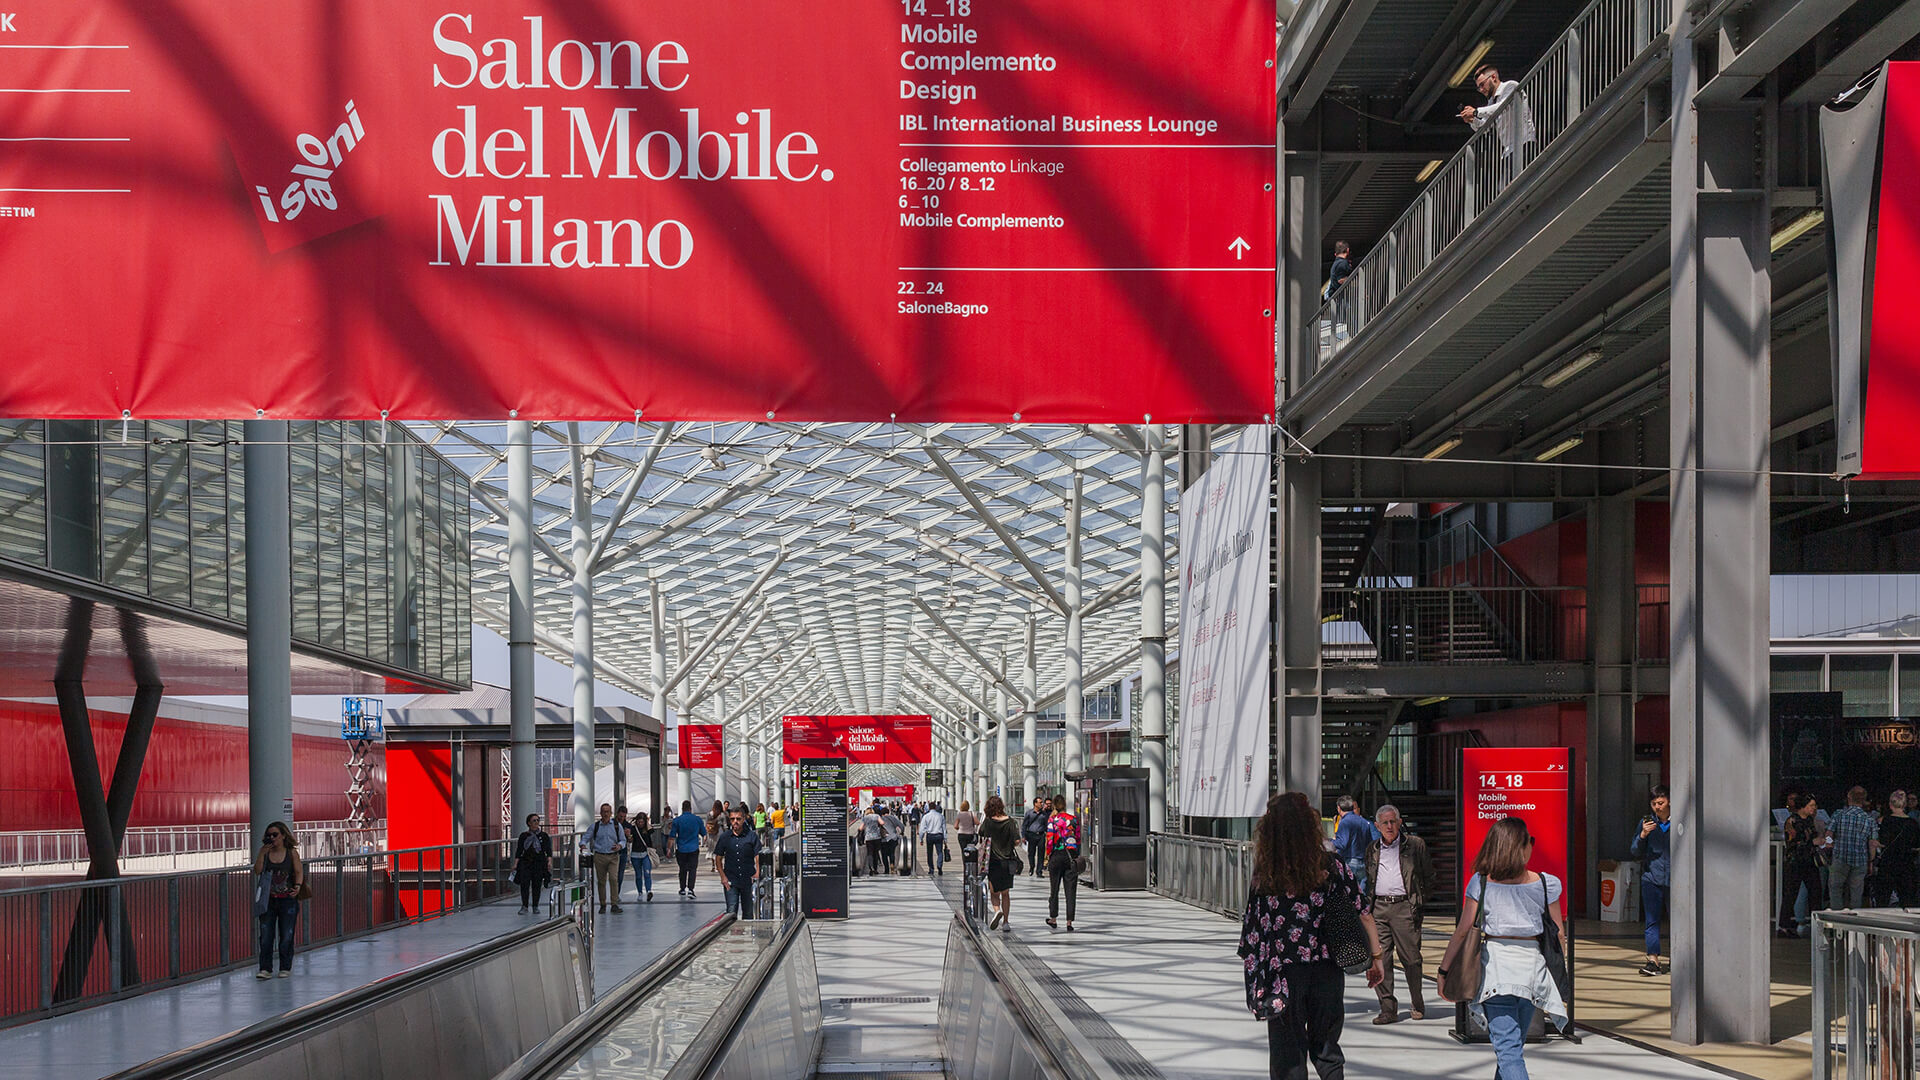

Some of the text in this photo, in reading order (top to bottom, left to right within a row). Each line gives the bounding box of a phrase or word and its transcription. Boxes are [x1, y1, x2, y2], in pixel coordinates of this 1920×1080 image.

[901, 23, 978, 44] Mobile
[432, 12, 690, 92] Salone
[900, 50, 1057, 75] Complemento
[900, 79, 977, 104] Design
[899, 114, 1218, 137] IBL International Business Lounge
[431, 105, 835, 182] del Mobile.
[899, 157, 1065, 176] Collegamento Linkage
[899, 176, 945, 191] 16_20
[959, 177, 996, 192] 8_12
[13, 207, 36, 218] TIM
[899, 212, 1065, 231] Mobile Complemento
[428, 194, 695, 270] Milano
[897, 281, 945, 295] 22_24
[897, 301, 989, 317] SaloneBagno
[849, 726, 874, 735] Salone
[849, 734, 861, 743] del
[849, 742, 875, 752] Milano
[1478, 774, 1524, 790] 14_18
[1478, 793, 1508, 803] Mobile
[1477, 803, 1537, 812] Complemento
[1477, 811, 1508, 821] Design
